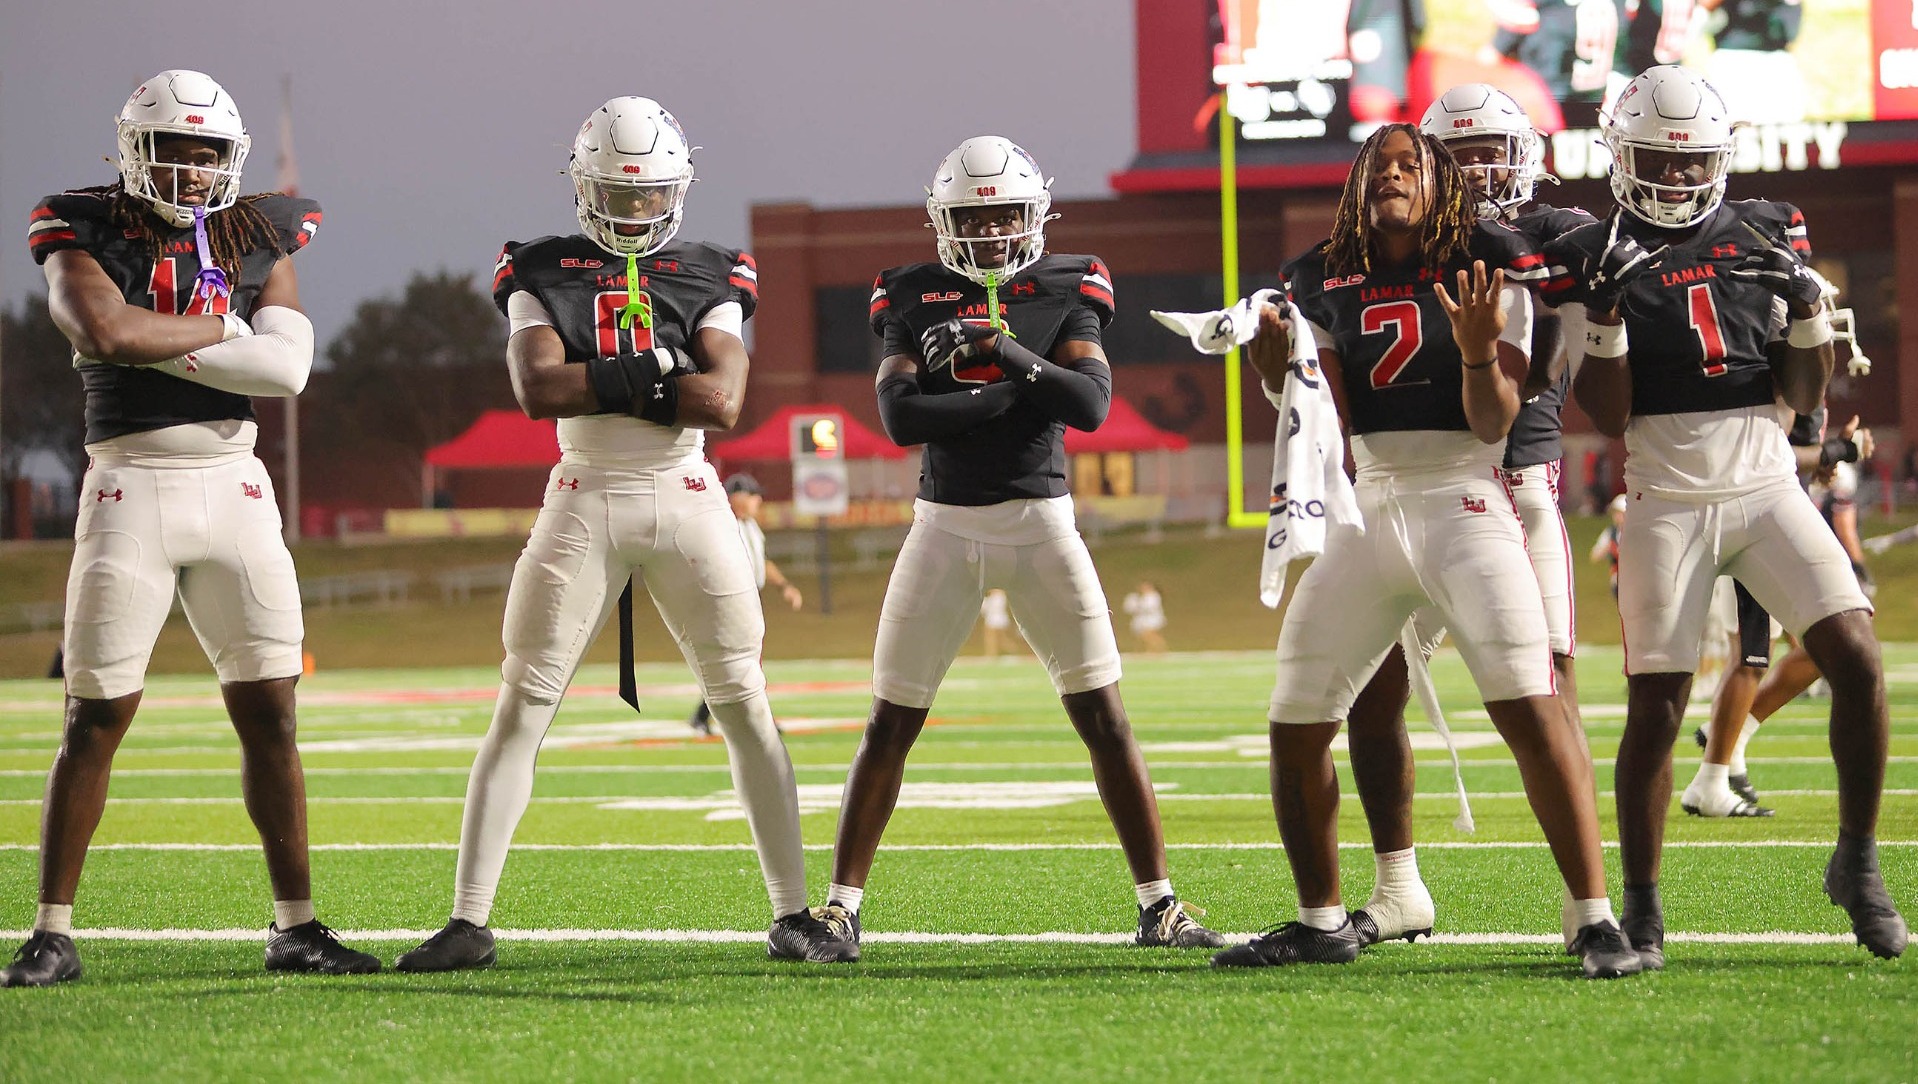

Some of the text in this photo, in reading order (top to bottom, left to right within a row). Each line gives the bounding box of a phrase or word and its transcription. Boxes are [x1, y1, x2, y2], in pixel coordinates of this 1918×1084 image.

[1552, 120, 1849, 180] UNSITY
[596, 273, 650, 288] LAMR
[1661, 264, 1718, 287] LAMAR
[1360, 284, 1415, 302] LAMAR
[957, 303, 1008, 317] LAMR
[1687, 282, 1729, 378] 1
[1360, 300, 1432, 391] 2
